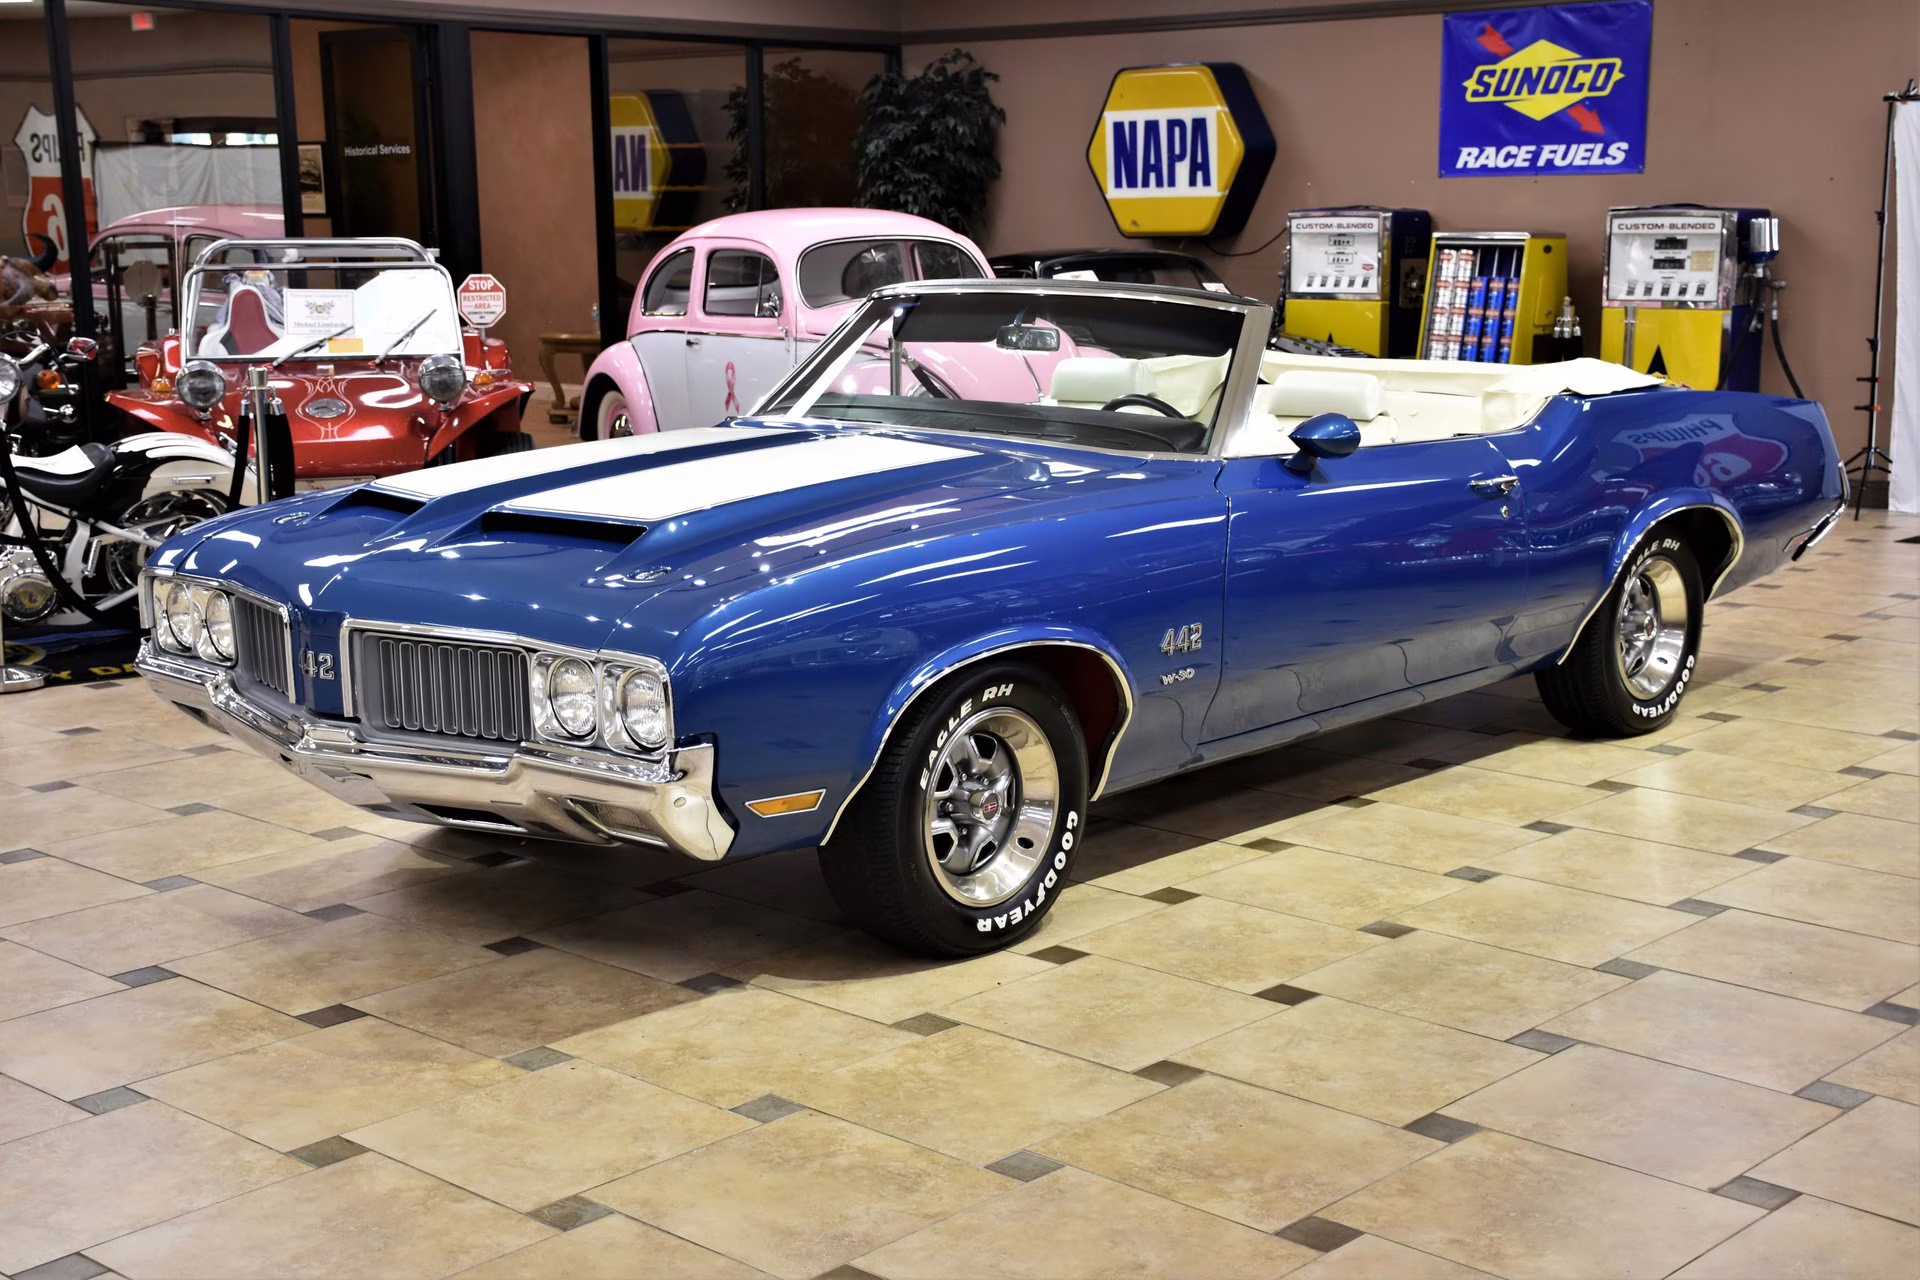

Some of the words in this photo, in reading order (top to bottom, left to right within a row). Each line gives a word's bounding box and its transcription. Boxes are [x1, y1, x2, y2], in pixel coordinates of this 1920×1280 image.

[1470, 62, 1617, 98] SUNOCO
[344, 145, 378, 156] Historical
[379, 144, 411, 155] Services
[1113, 117, 1212, 189] NAPA
[1455, 145, 1537, 169] RACE
[1536, 142, 1629, 167] FUELS
[468, 279, 494, 291] STOP
[1662, 538, 1681, 551] RH
[1160, 622, 1203, 656] 442
[1632, 654, 1695, 718] GOODYEAR
[919, 699, 973, 790] EAGLE
[982, 683, 1014, 702] RH
[976, 810, 1079, 932] GOODYEAR
